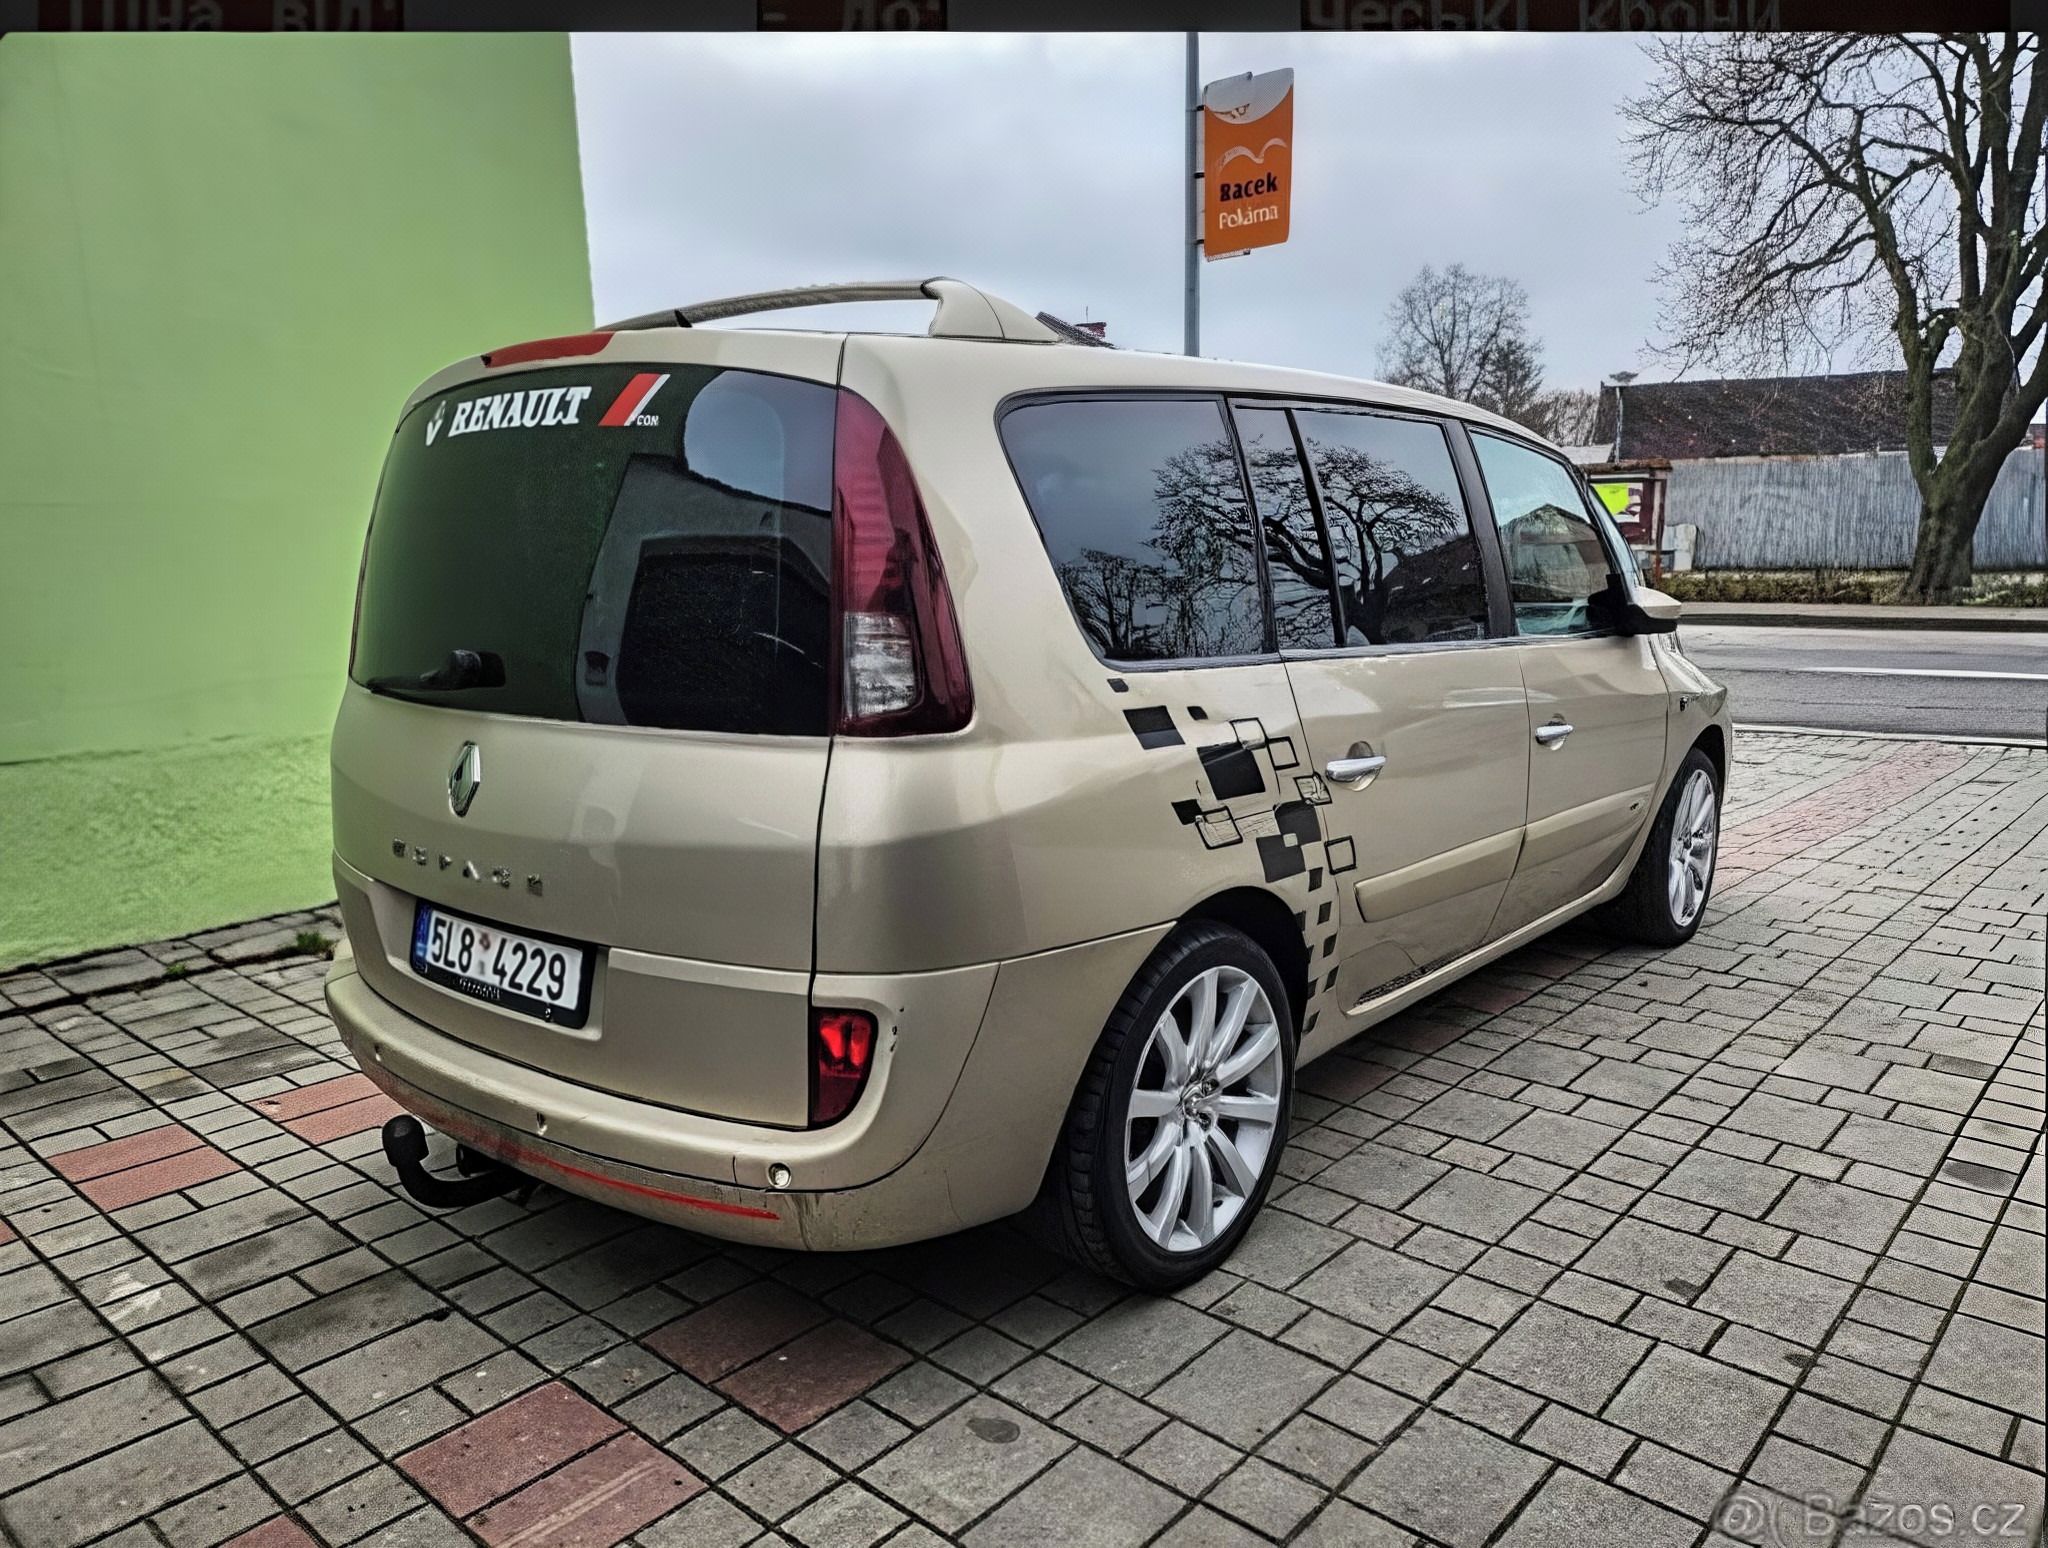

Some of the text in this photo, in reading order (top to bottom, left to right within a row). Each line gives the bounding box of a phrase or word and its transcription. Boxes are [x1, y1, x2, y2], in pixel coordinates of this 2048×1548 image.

[448, 386, 592, 437] RENAULT
[430, 916, 566, 1002] 5L8 4229
